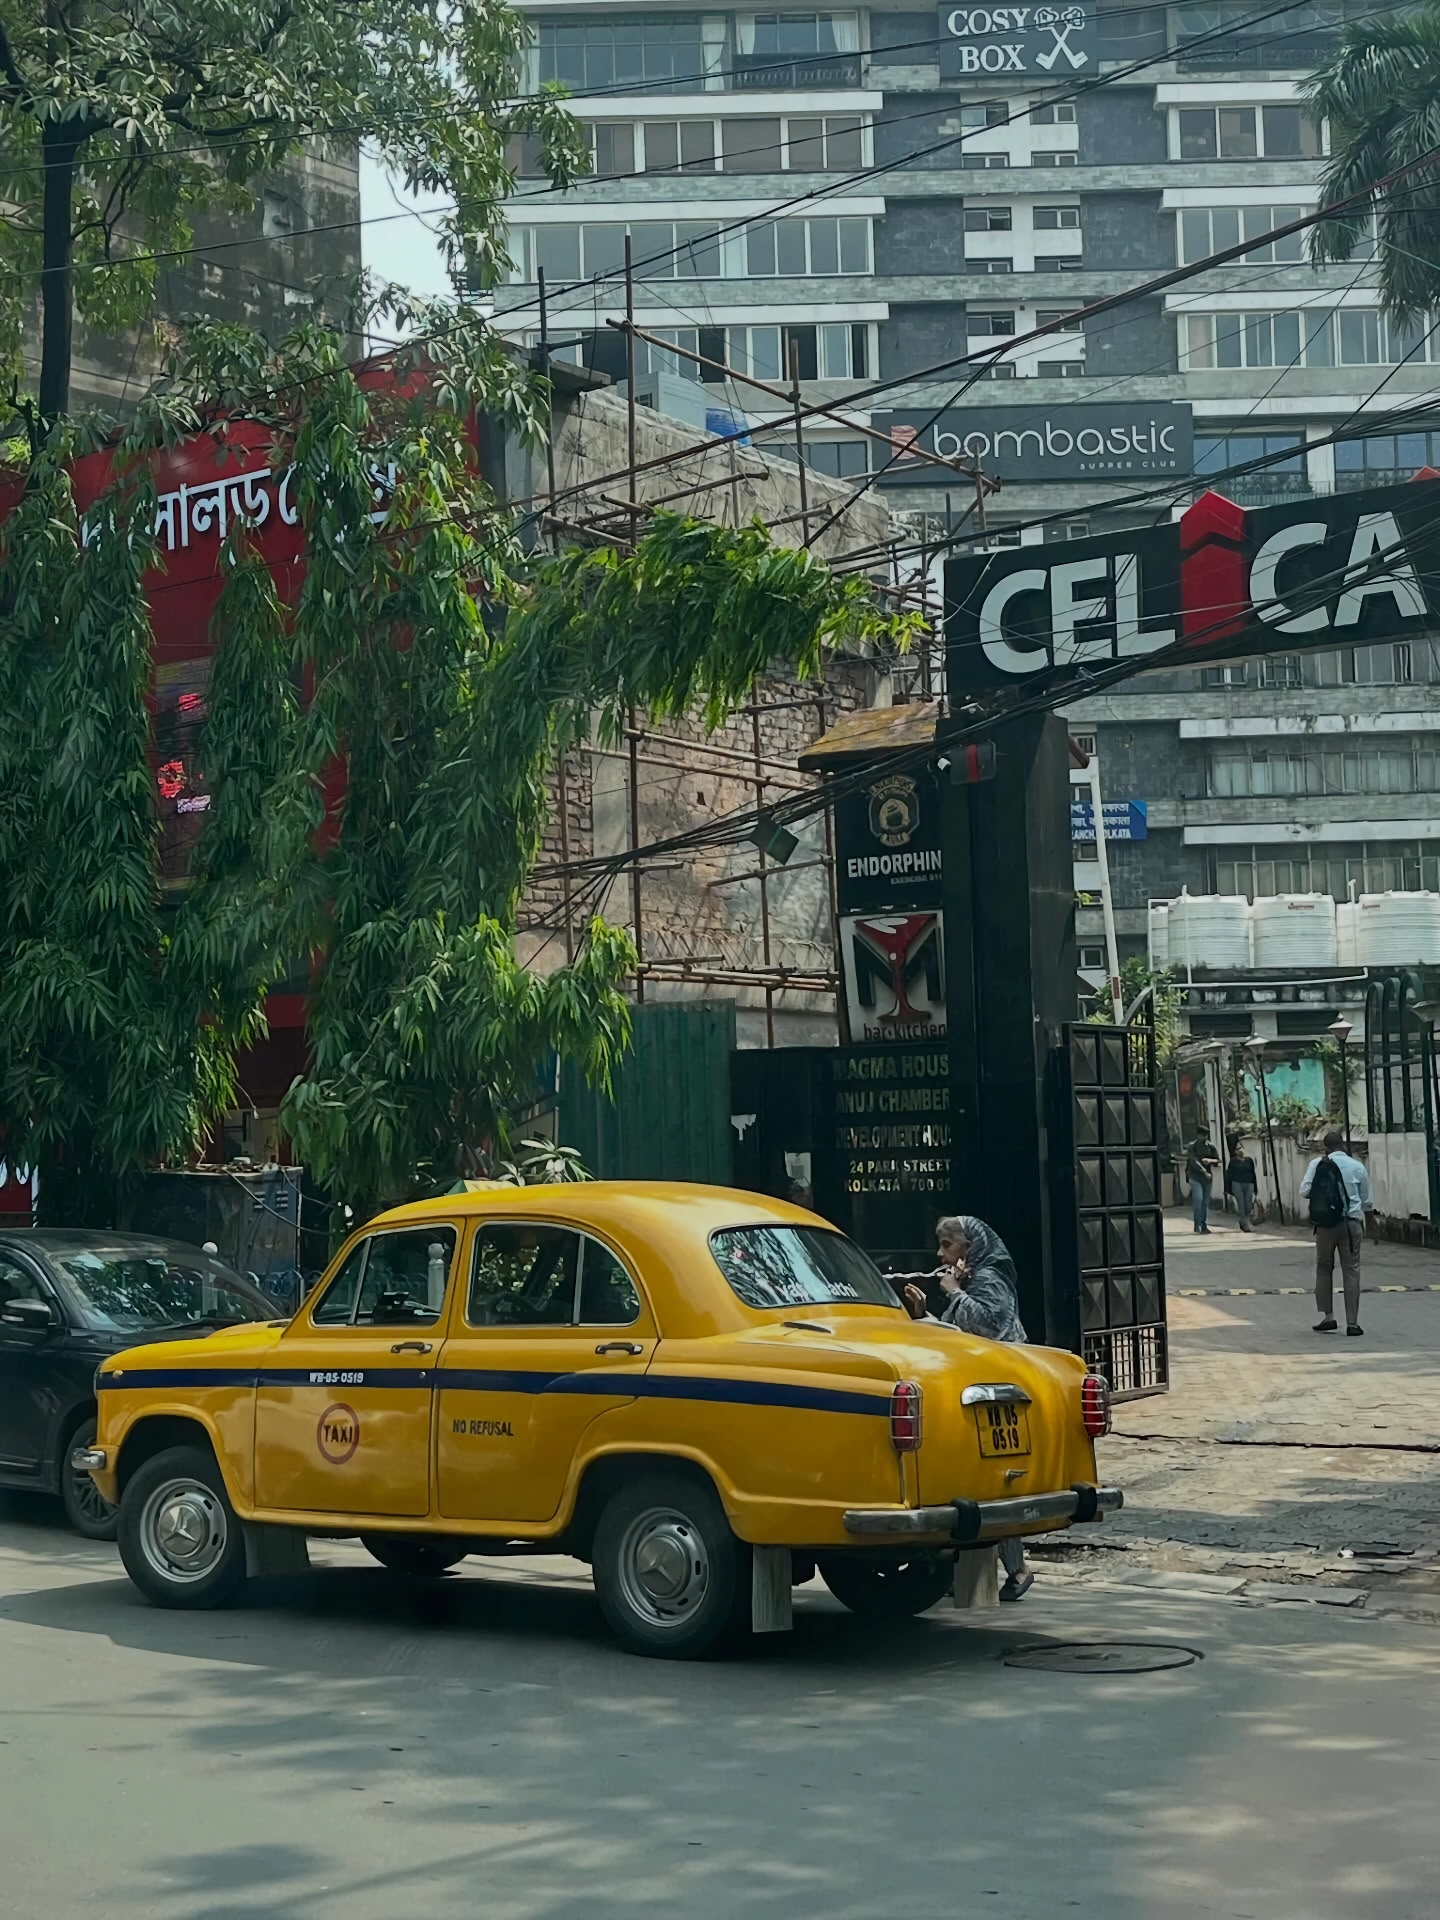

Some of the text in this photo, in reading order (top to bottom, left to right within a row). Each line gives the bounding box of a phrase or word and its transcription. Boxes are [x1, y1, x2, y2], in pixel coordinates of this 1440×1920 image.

[947, 8, 1031, 36] COSY
[958, 44, 1027, 73] BOX
[933, 420, 1175, 459] bombastic
[1142, 460, 1177, 468] CLUB
[847, 849, 942, 878] ENDORPHIN
[850, 1159, 864, 1174] 24
[903, 1158, 951, 1172] STREET
[324, 1424, 353, 1443] TAXI
[452, 1419, 514, 1436] NO REFUSAL
[992, 1428, 1020, 1450] 0519
